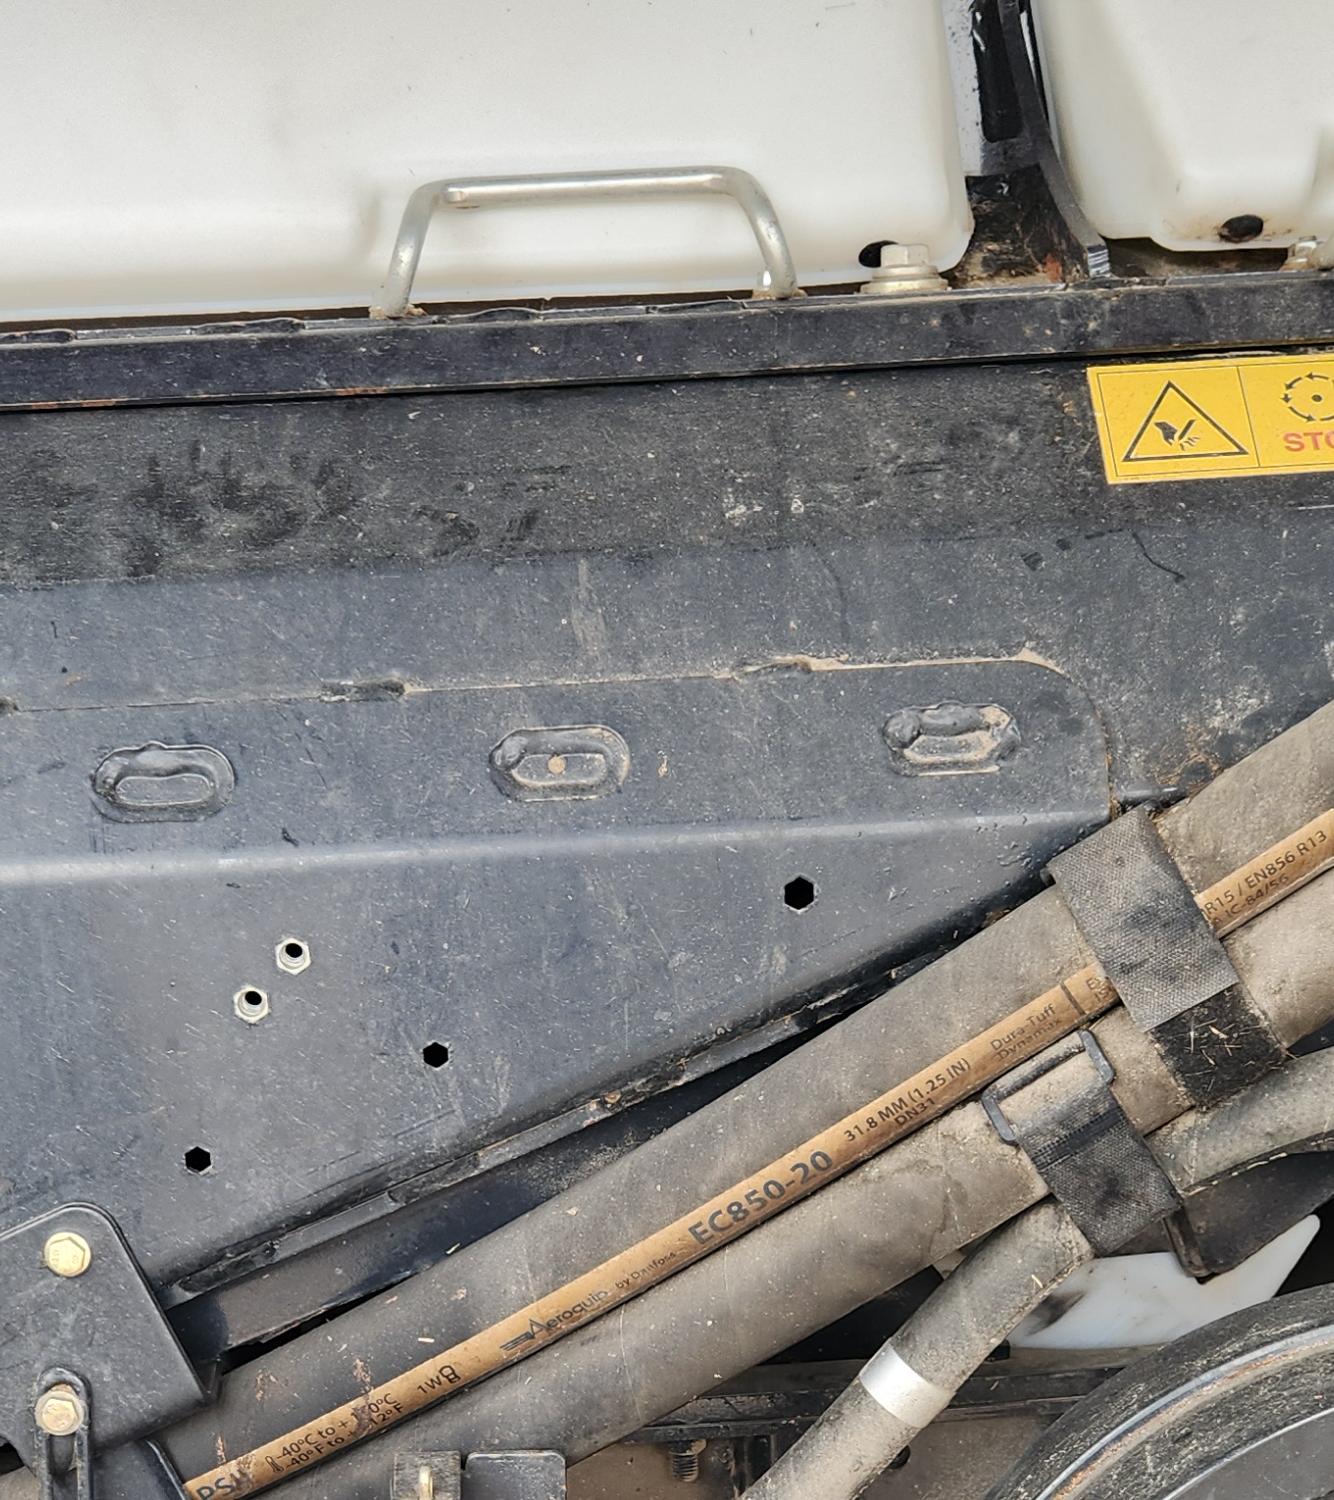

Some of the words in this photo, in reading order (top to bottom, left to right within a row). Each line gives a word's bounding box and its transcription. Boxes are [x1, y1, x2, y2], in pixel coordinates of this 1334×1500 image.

[1245, 851, 1296, 889] EN856
[1297, 830, 1328, 855] R13
[1225, 873, 1289, 919] IC-84/56
[990, 1003, 1057, 1051] Dura-Tuff
[997, 1018, 1063, 1060] Dynamax
[844, 1116, 878, 1142] 31.8
[878, 1096, 908, 1122] MM
[908, 1073, 947, 1105] (1.25
[946, 1057, 971, 1080] IN)
[895, 1097, 935, 1126] DN31
[689, 1150, 833, 1245] EC850-20
[531, 1290, 608, 1338] Aeroquip
[614, 1275, 632, 1292] by
[631, 1250, 678, 1279] Danfoss
[317, 1424, 336, 1440] to
[327, 1435, 345, 1450] to
